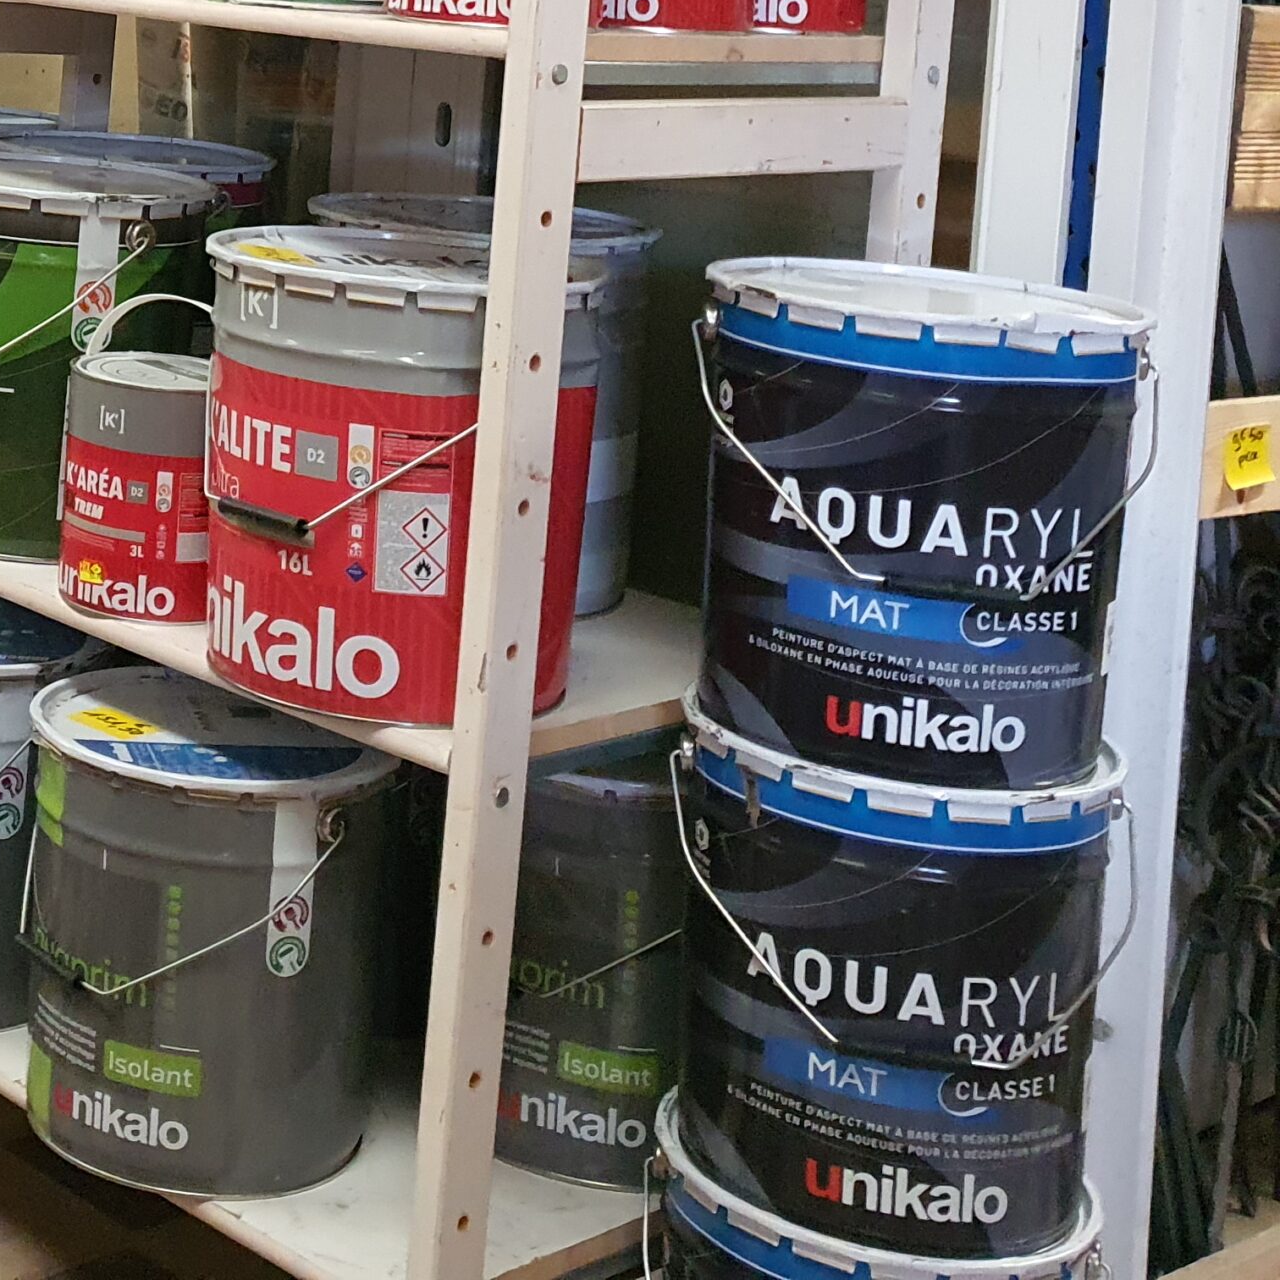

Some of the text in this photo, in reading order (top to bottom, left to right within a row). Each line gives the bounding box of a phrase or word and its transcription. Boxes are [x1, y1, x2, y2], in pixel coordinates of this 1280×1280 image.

[307, 448, 325, 464] D2
[770, 476, 1094, 560] AQUARYL
[129, 545, 144, 558] 3L
[278, 549, 313, 576] 16L
[830, 590, 910, 630] MAT
[976, 612, 1063, 632] CLASSE
[772, 628, 824, 651] PEINTURE
[888, 655, 912, 668] MAT
[928, 660, 959, 673] BASE
[825, 657, 863, 675] PHASE
[867, 668, 924, 685] AQUEUSE
[928, 674, 961, 688] POUR
[825, 694, 1026, 753] unikalo
[108, 1051, 193, 1088] Isolant
[562, 1051, 651, 1086] Isolant
[808, 1052, 888, 1097] MAT
[955, 1076, 1044, 1101] CLASSE
[805, 1157, 1008, 1224] unikalo
